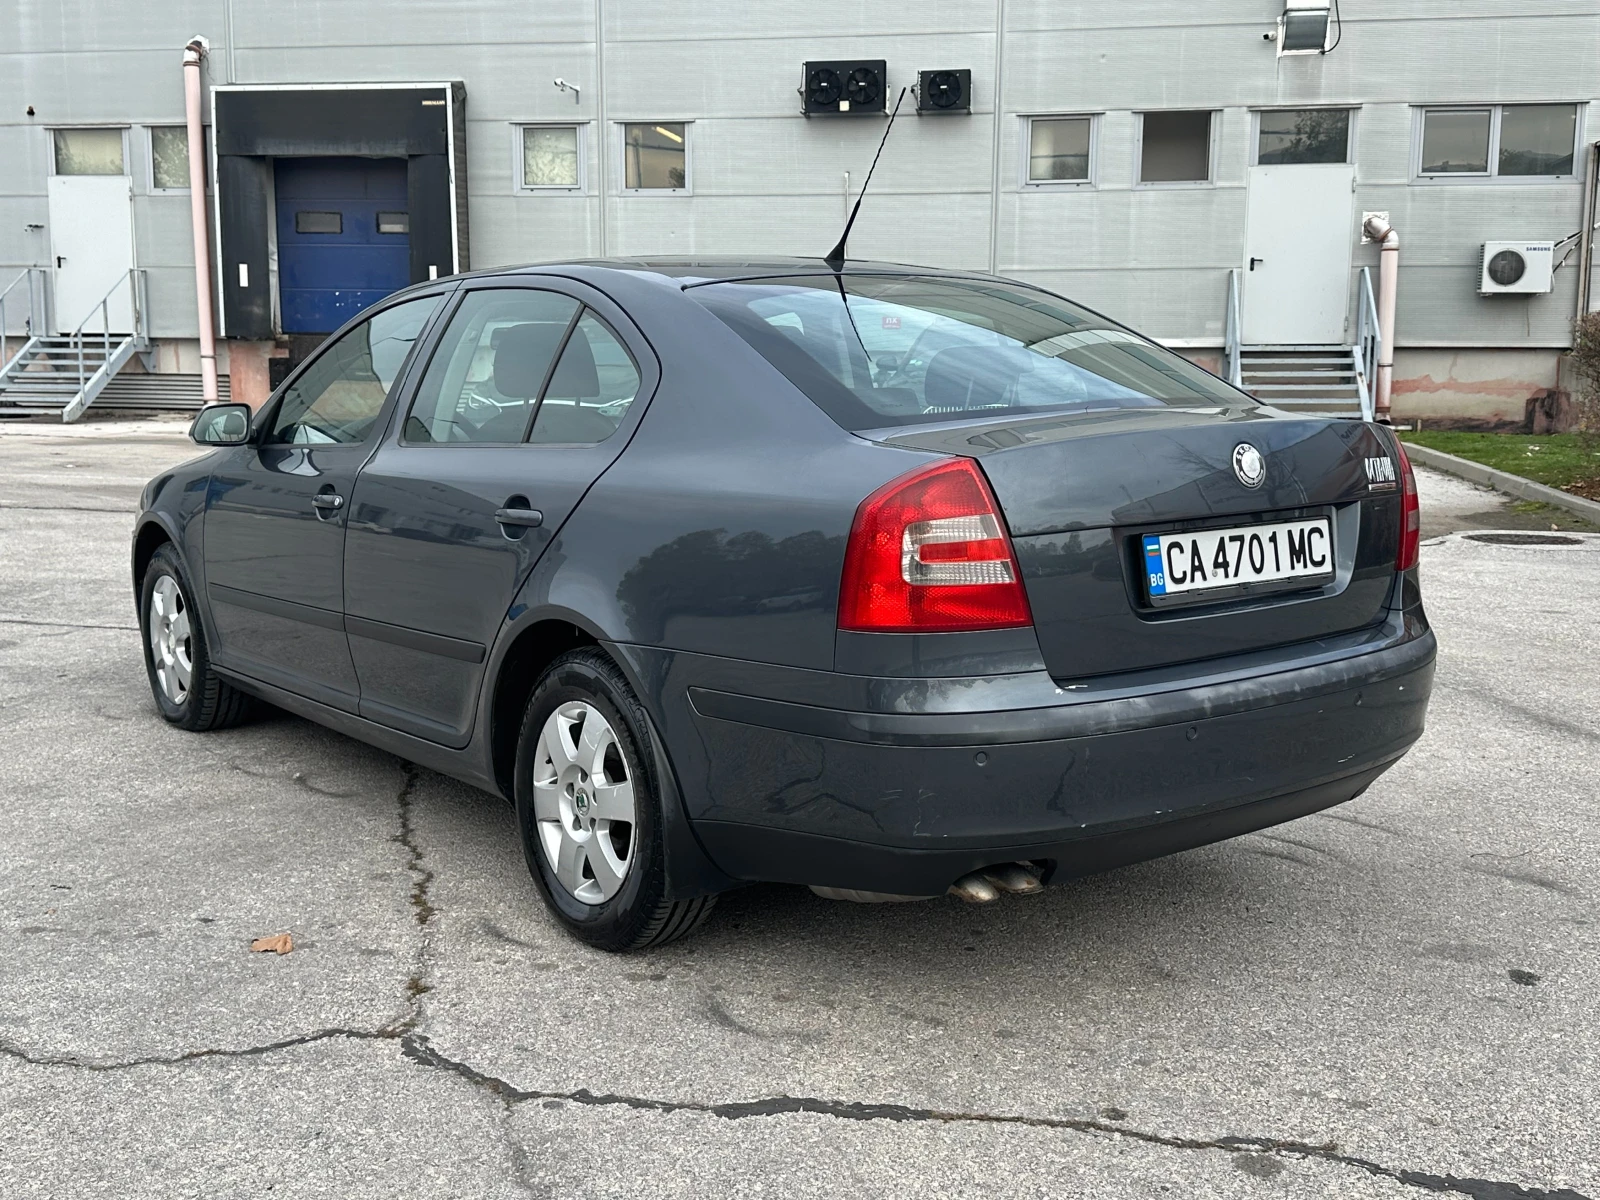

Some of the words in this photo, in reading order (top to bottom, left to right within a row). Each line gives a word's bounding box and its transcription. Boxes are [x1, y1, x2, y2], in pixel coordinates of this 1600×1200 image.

[1166, 539, 1207, 585] CA
[1213, 531, 1281, 578] 4701
[1287, 527, 1326, 571] MC
[1150, 573, 1164, 587] BG
